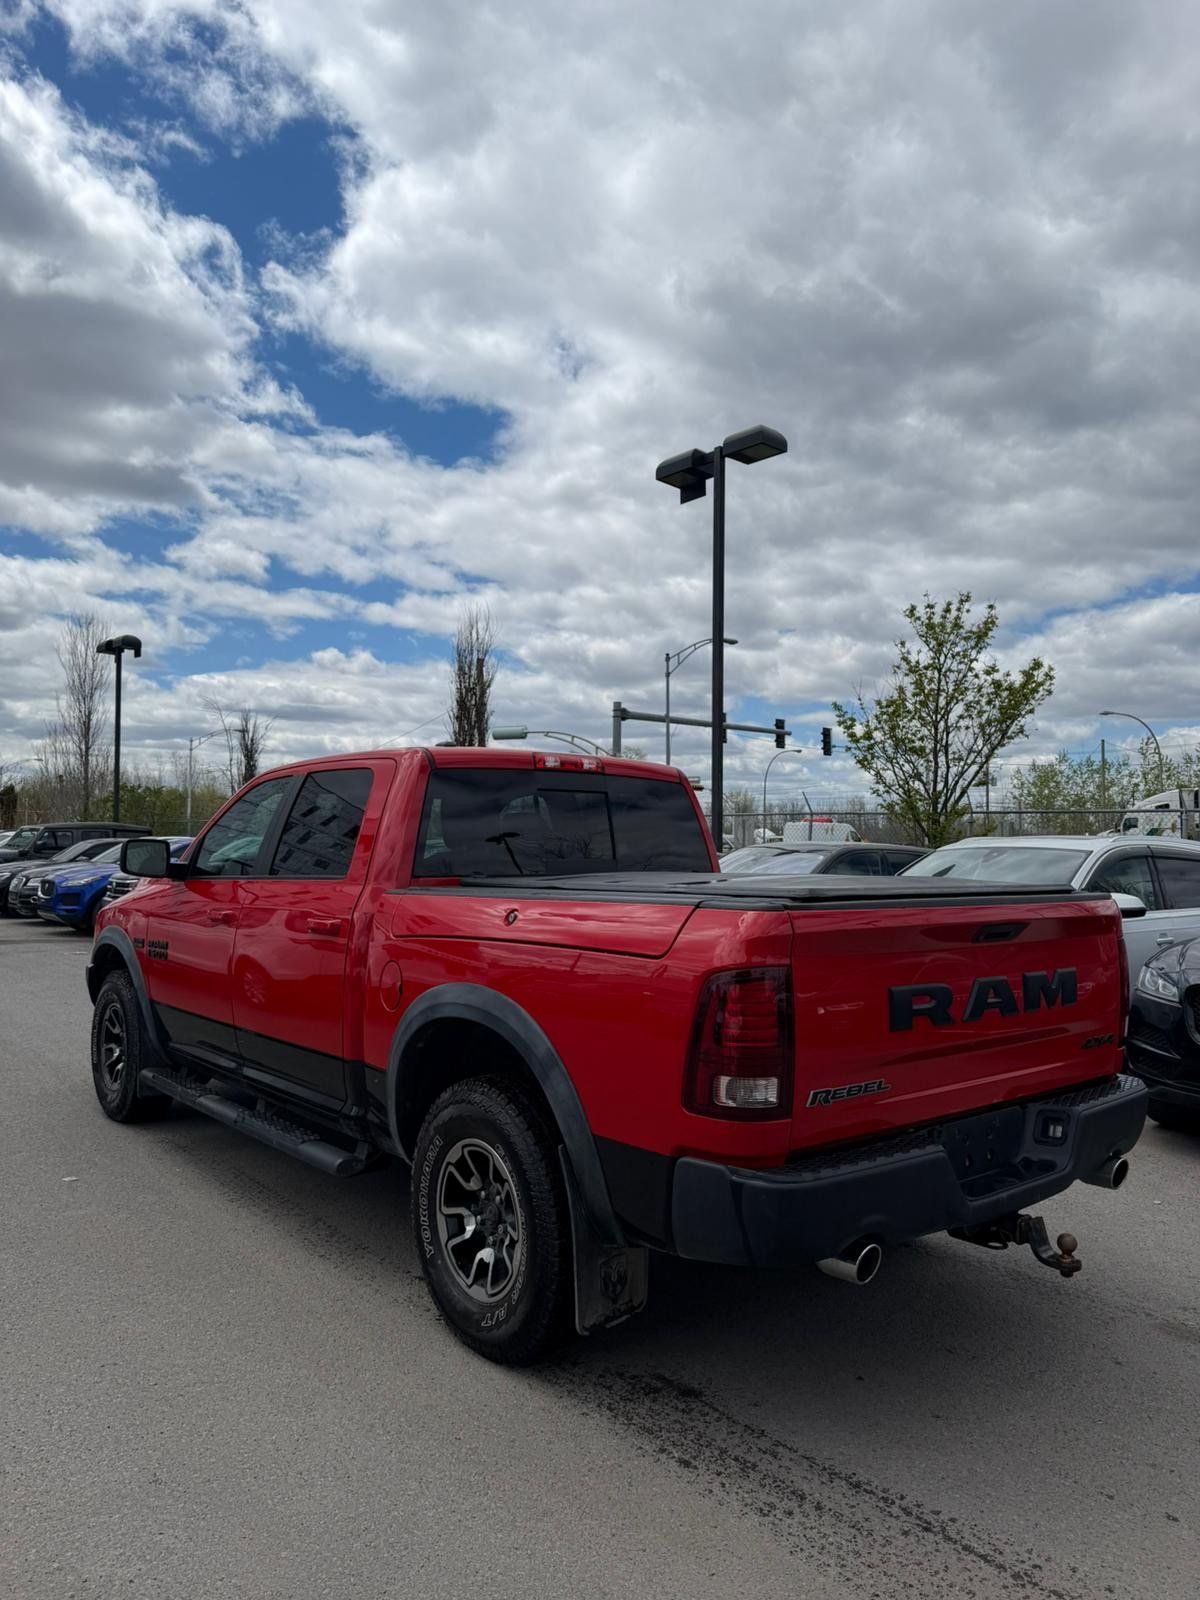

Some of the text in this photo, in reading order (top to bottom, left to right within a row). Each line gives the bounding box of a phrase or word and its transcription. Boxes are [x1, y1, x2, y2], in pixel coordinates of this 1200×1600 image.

[888, 967, 1077, 1032] RAM
[806, 1079, 891, 1107] REBEL
[417, 1135, 444, 1259] YOKOHAMA
